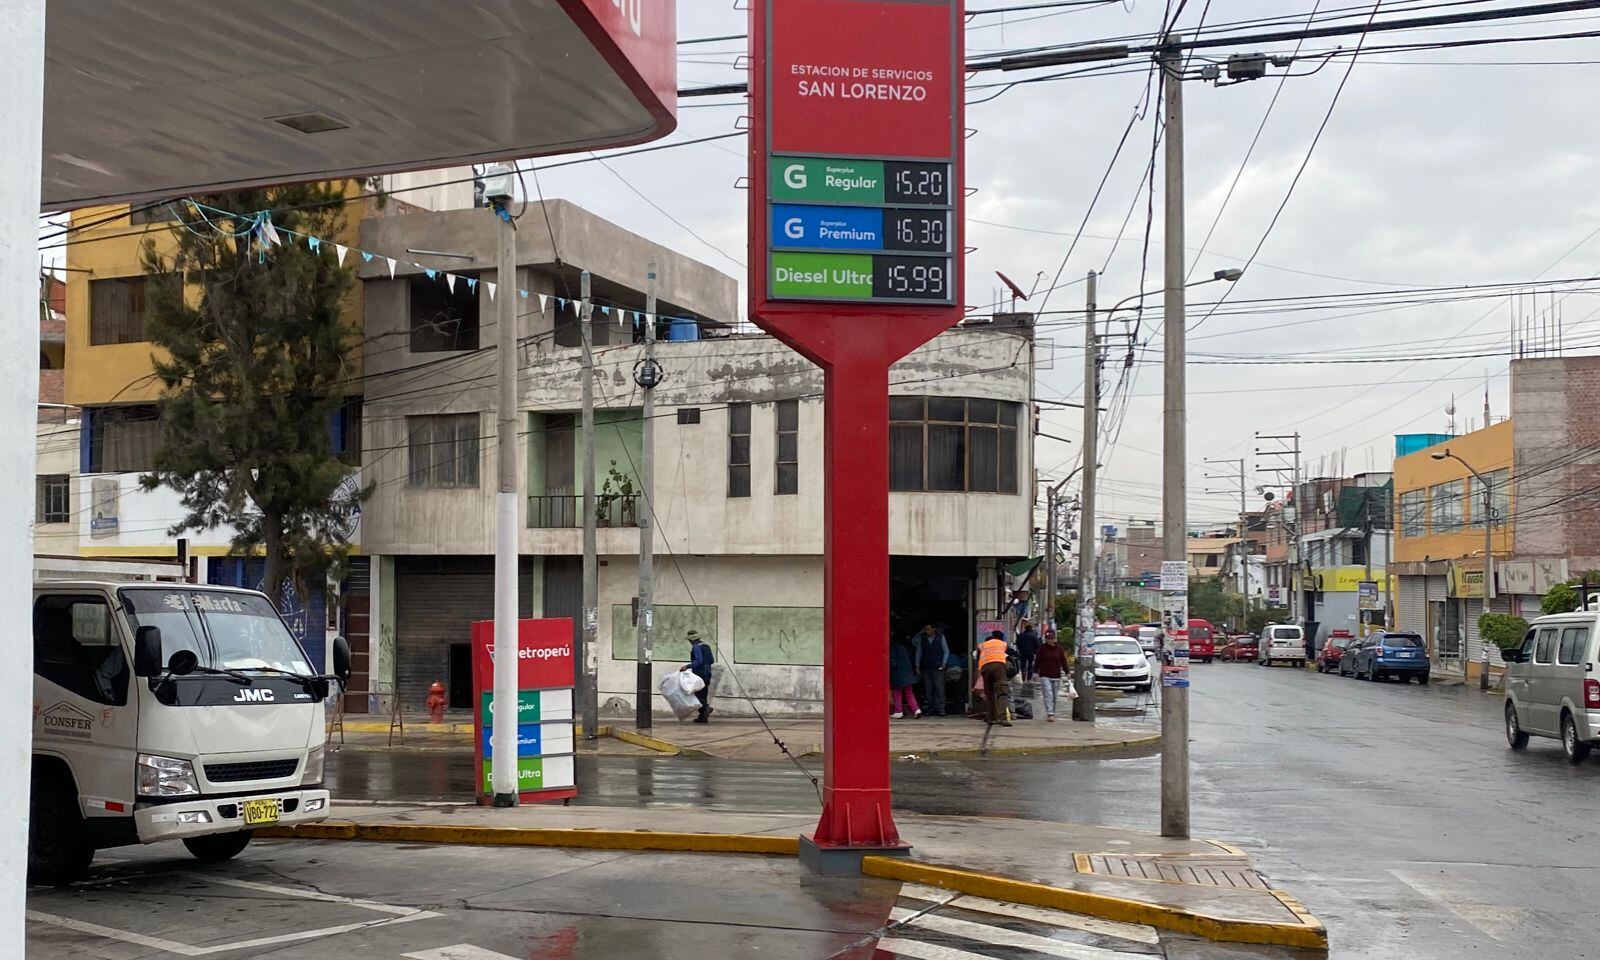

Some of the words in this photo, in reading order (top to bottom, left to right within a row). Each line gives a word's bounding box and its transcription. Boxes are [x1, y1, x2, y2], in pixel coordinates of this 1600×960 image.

[791, 64, 850, 77] ESTACION
[853, 67, 869, 78] DE
[872, 68, 934, 81] SERVICIOS
[798, 80, 836, 97] SAN
[841, 82, 927, 101] LORENZO
[783, 164, 808, 189] G
[825, 175, 877, 191] Regular
[897, 170, 942, 195] 15.20
[784, 217, 805, 239] G
[819, 227, 876, 241] Premium
[897, 218, 943, 244] 16.30
[775, 267, 828, 283] Diesel
[888, 265, 943, 292] 15.99
[518, 644, 570, 661] etroperú
[233, 688, 275, 702] JMC
[518, 703, 535, 713] gular
[44, 715, 92, 730] CONSFER
